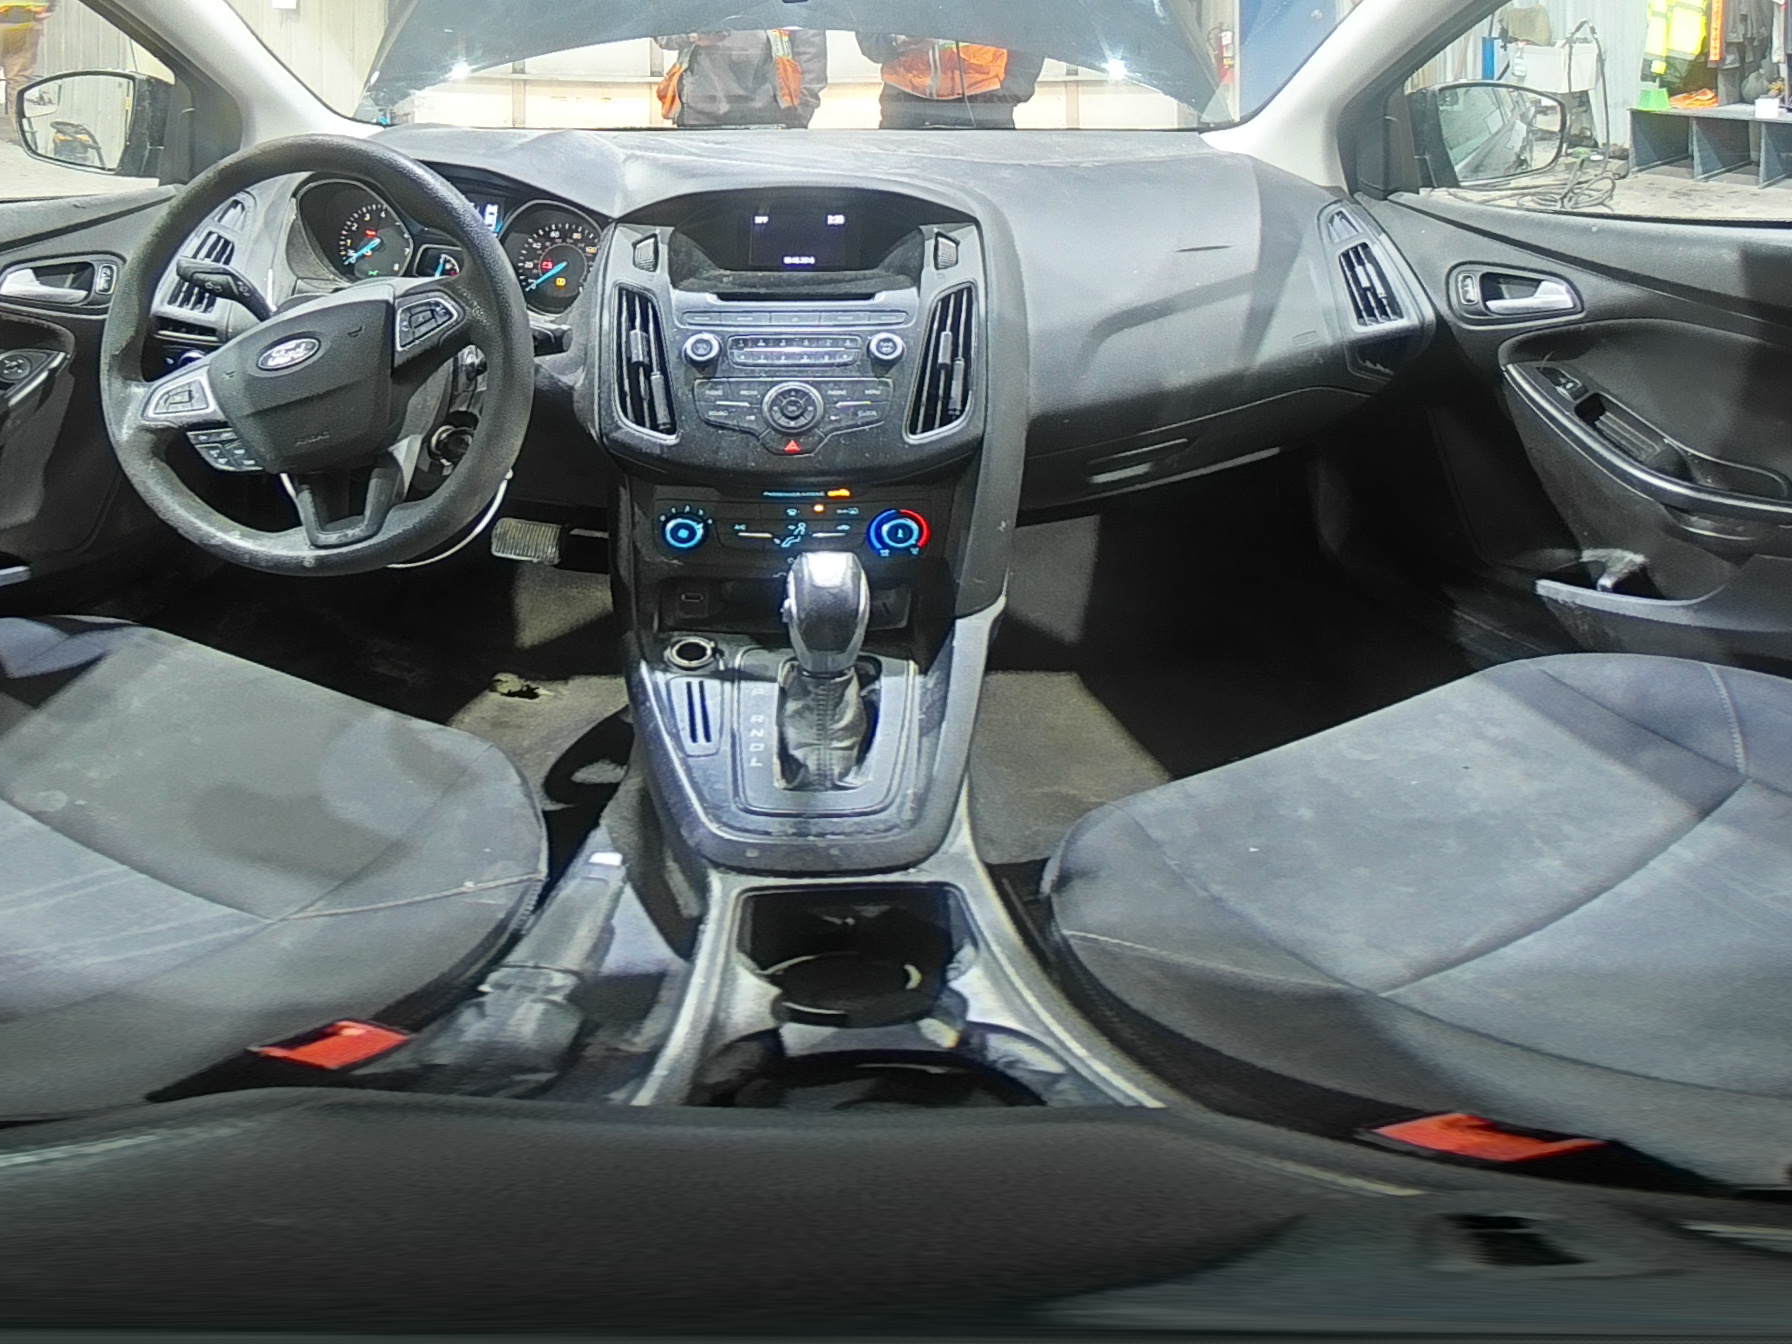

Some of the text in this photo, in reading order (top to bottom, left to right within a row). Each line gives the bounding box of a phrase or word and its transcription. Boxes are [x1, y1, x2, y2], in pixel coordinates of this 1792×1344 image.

[268, 343, 308, 366] Ford
[750, 714, 765, 724] R
[750, 728, 764, 737] N
